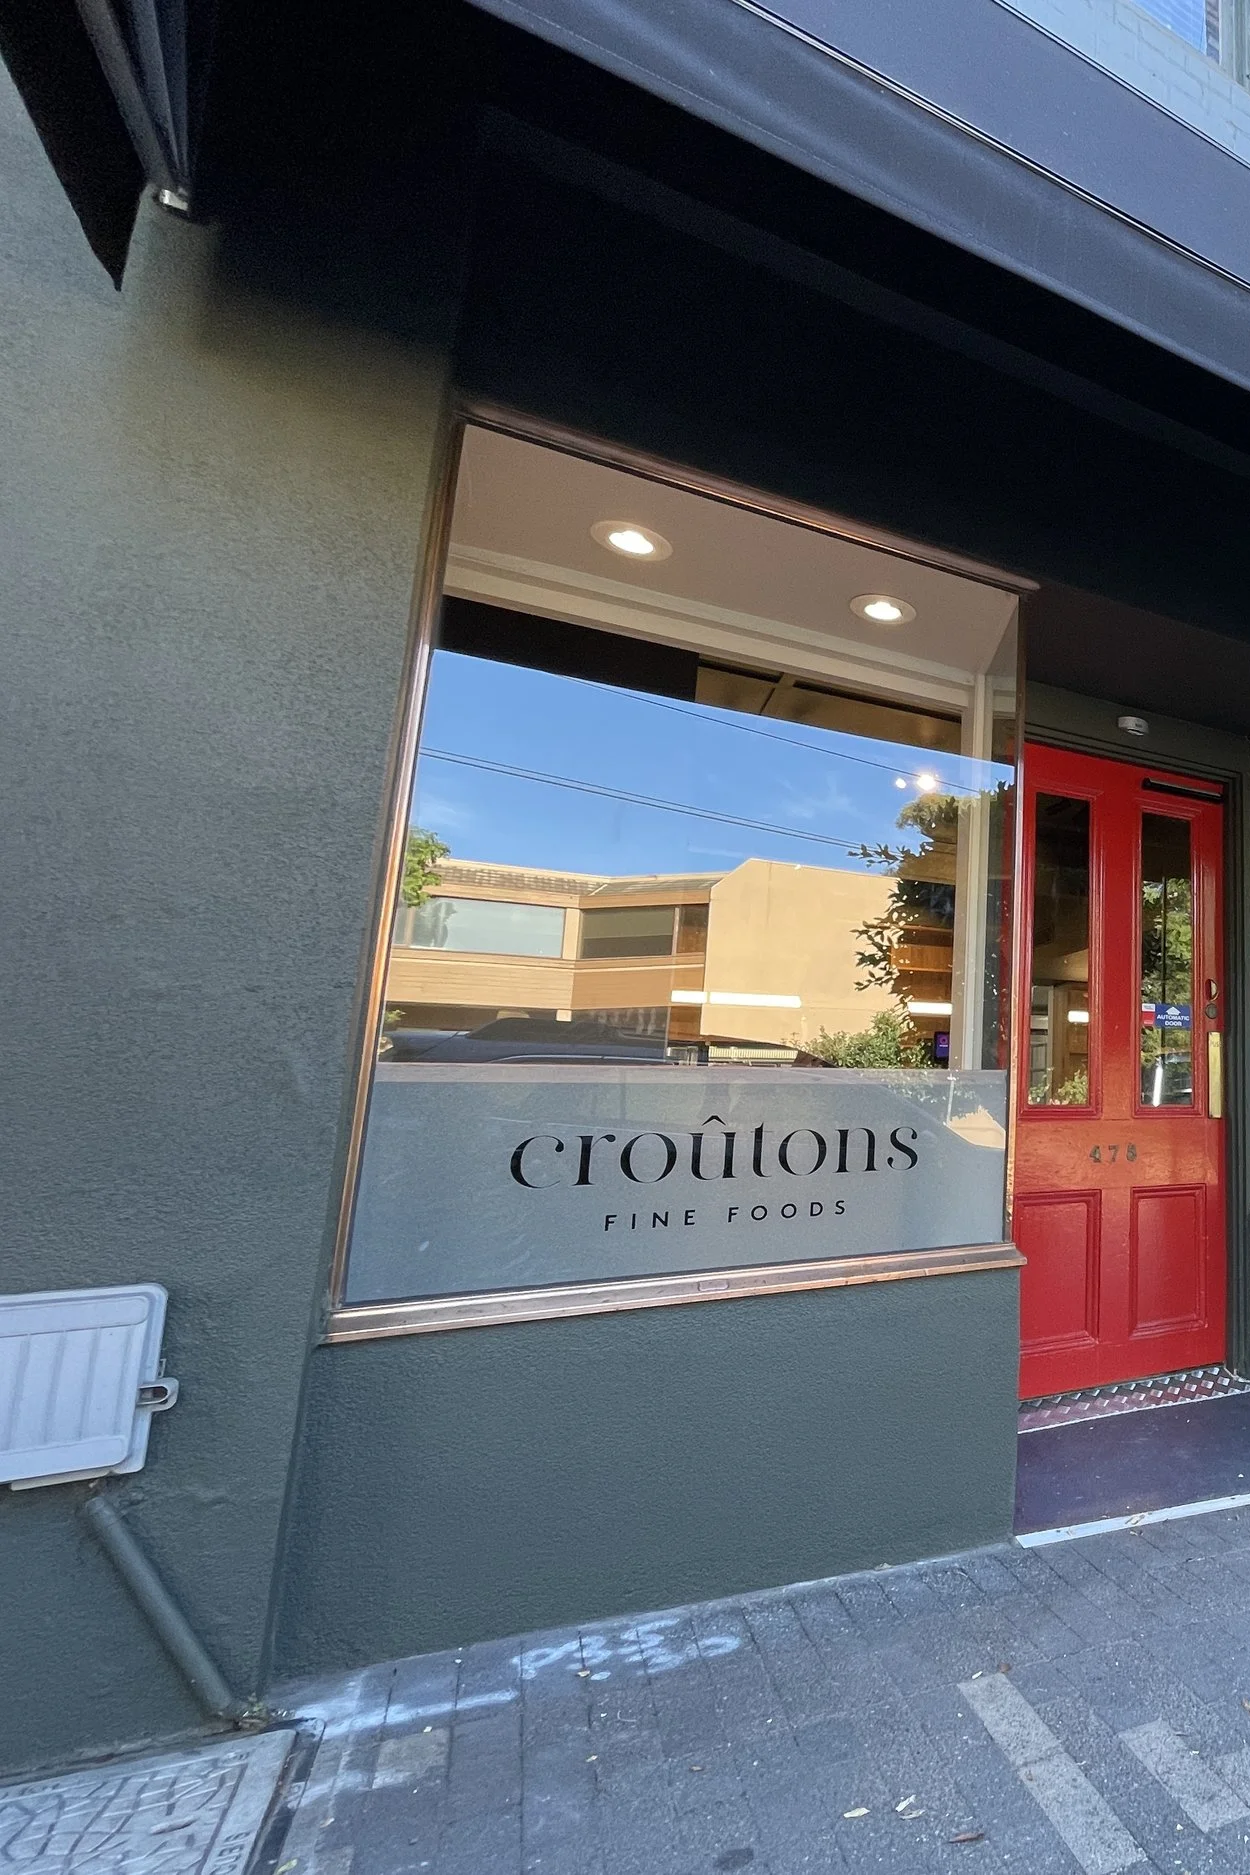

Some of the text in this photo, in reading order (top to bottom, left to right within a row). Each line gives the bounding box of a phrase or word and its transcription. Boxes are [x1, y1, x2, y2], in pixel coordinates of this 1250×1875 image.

[510, 1115, 919, 1189] croûtons
[604, 1199, 846, 1232] FINE FOODS
